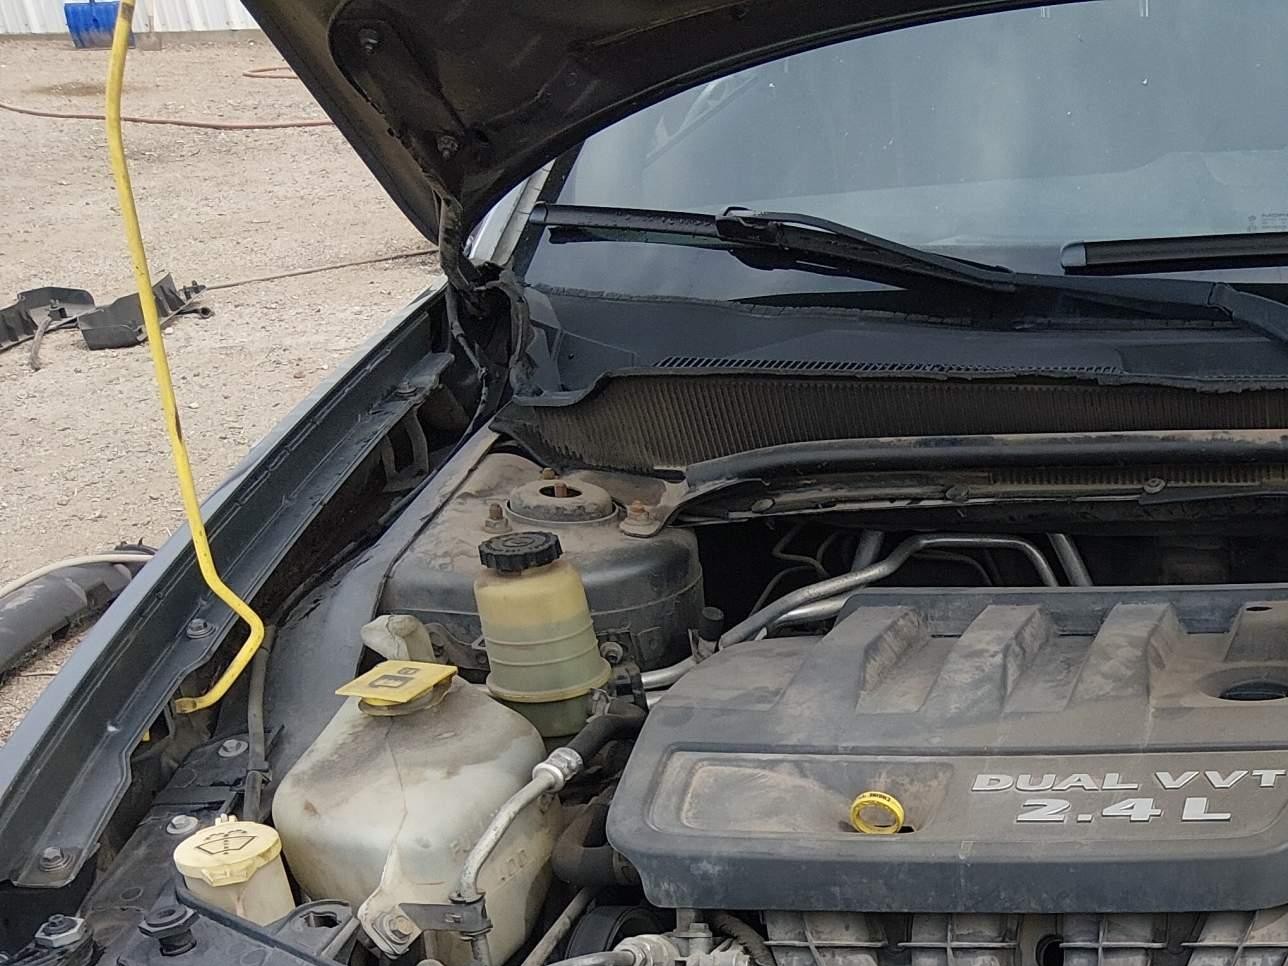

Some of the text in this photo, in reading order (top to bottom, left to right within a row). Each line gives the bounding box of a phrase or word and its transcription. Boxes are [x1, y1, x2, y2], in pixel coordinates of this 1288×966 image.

[971, 768, 1288, 792] DUAL VVT
[1016, 797, 1232, 823] 2.4 L
